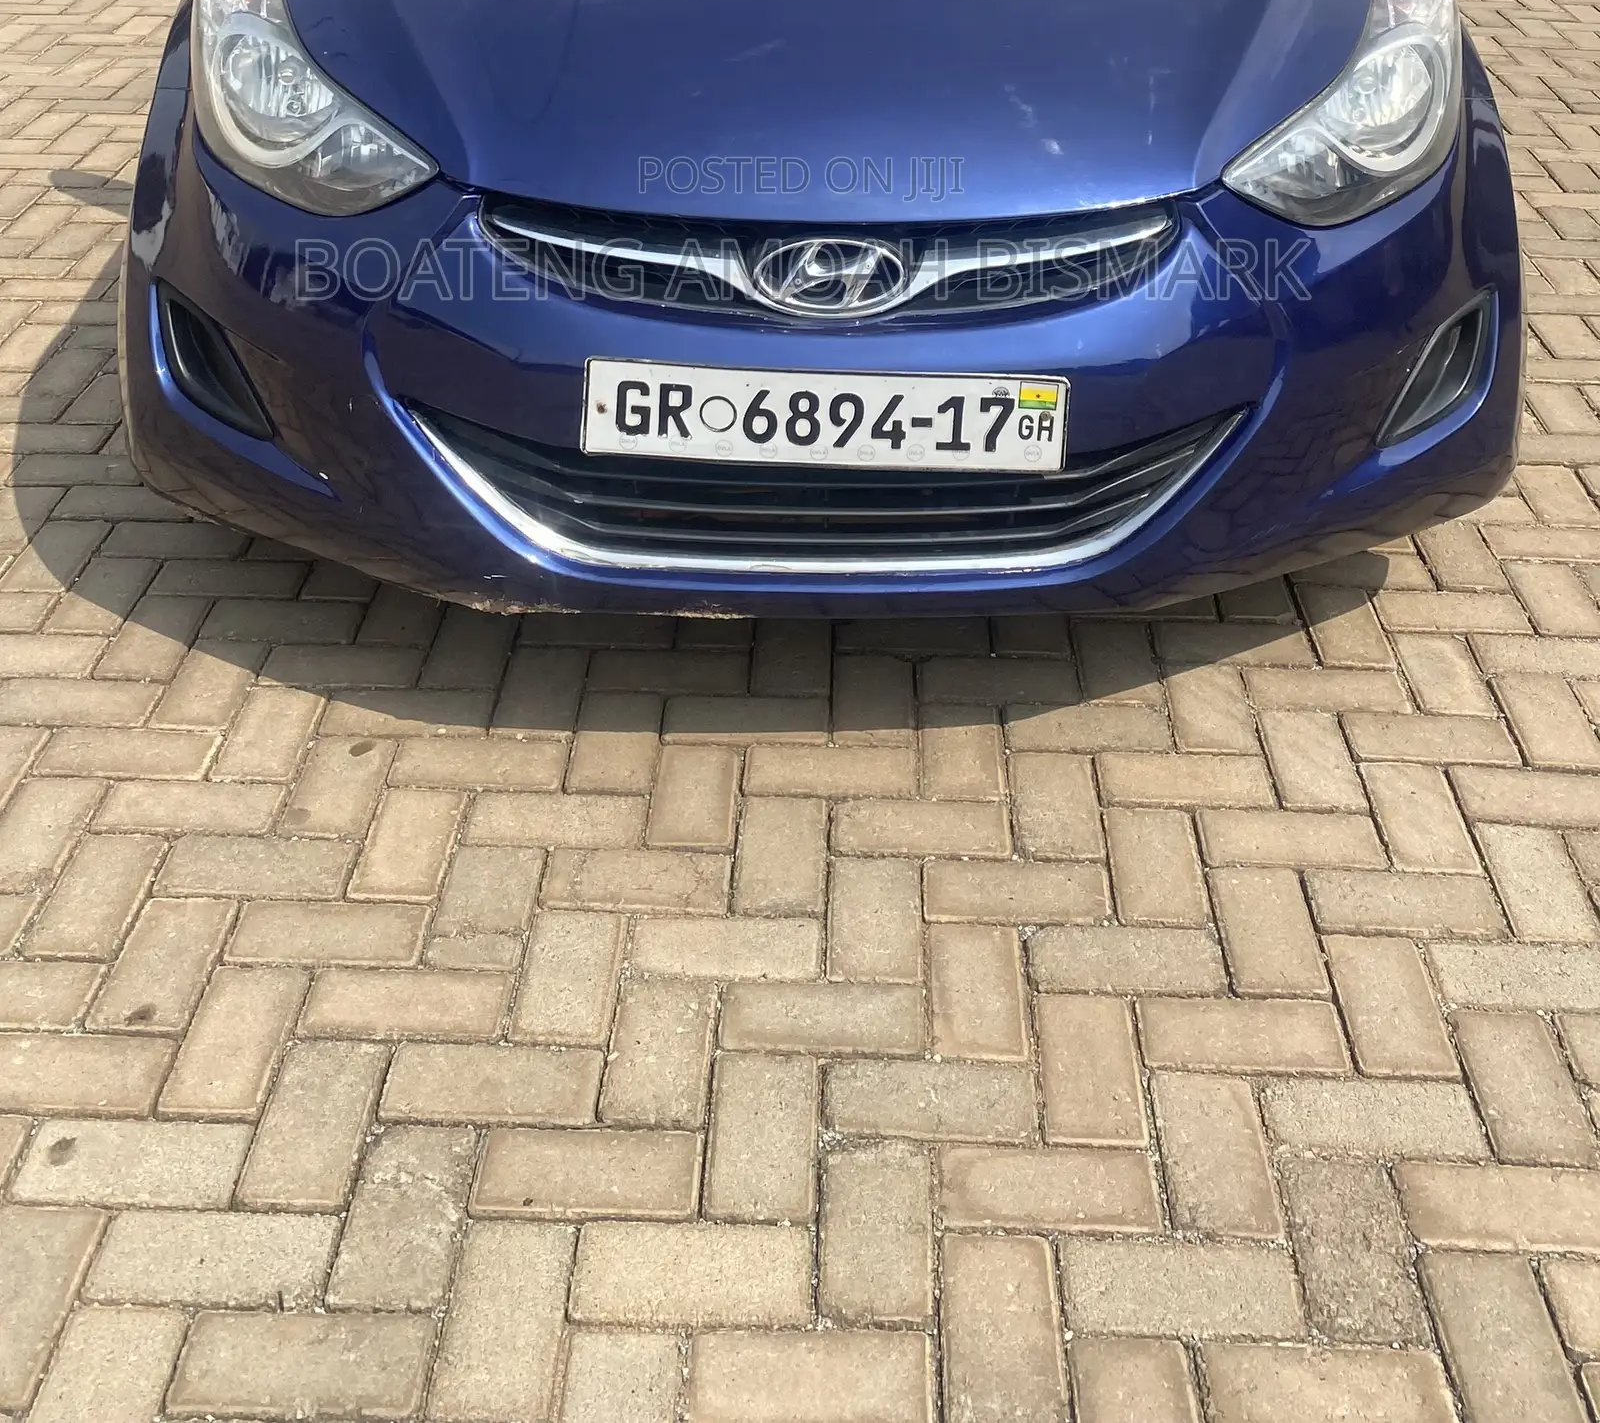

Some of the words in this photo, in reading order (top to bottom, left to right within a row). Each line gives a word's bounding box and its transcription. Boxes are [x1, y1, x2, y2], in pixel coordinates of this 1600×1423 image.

[615, 380, 693, 440] GR
[742, 389, 1016, 453] 6894-17
[1018, 413, 1054, 442] GH
